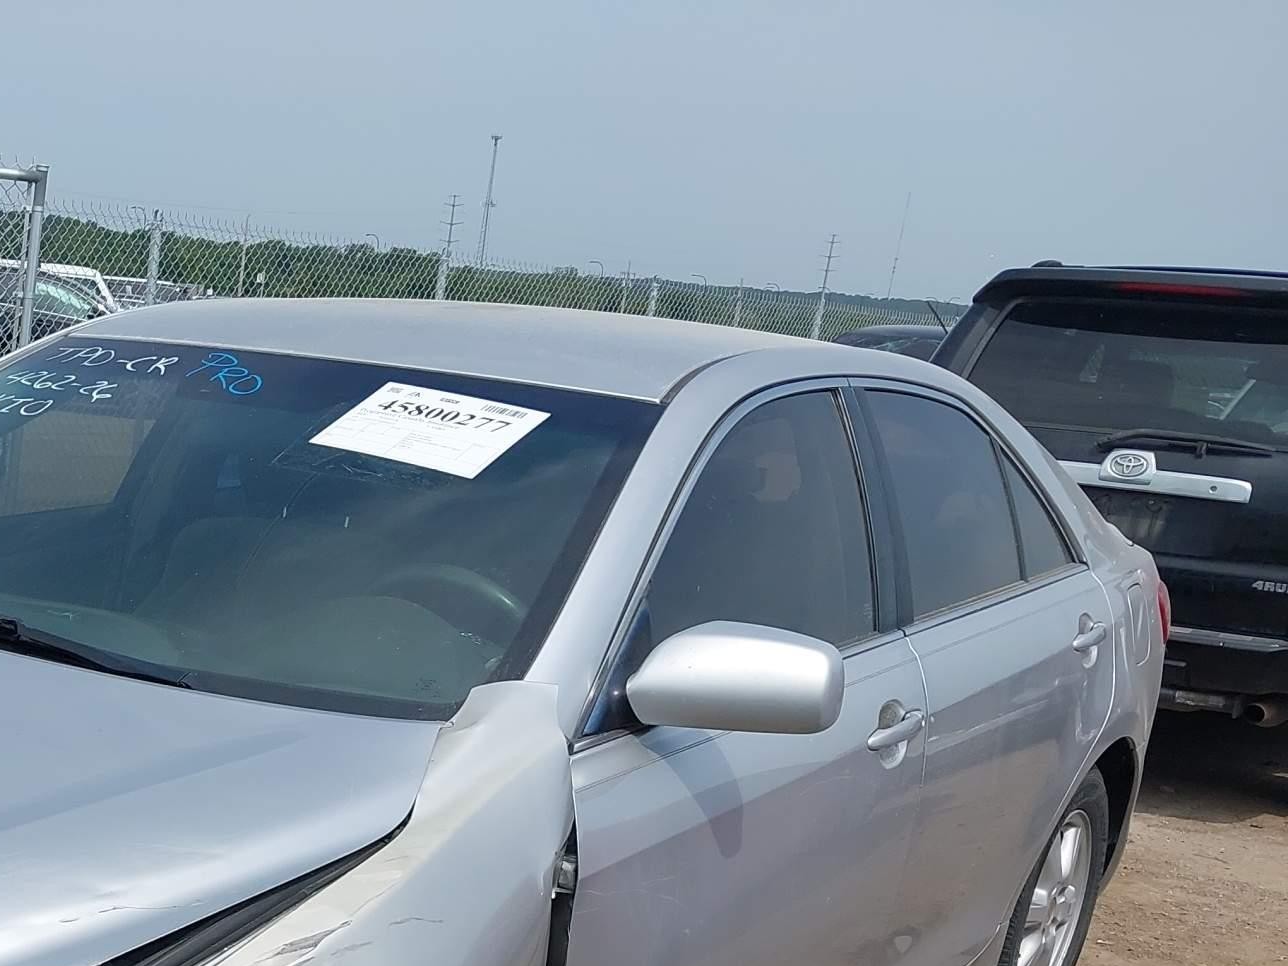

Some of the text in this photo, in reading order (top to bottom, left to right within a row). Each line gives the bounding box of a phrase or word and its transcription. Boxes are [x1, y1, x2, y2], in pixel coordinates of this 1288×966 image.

[6, 371, 118, 402] 4262-26
[186, 352, 263, 395] PRO
[378, 399, 512, 433] 45800277
[1252, 580, 1288, 594] 4RU
